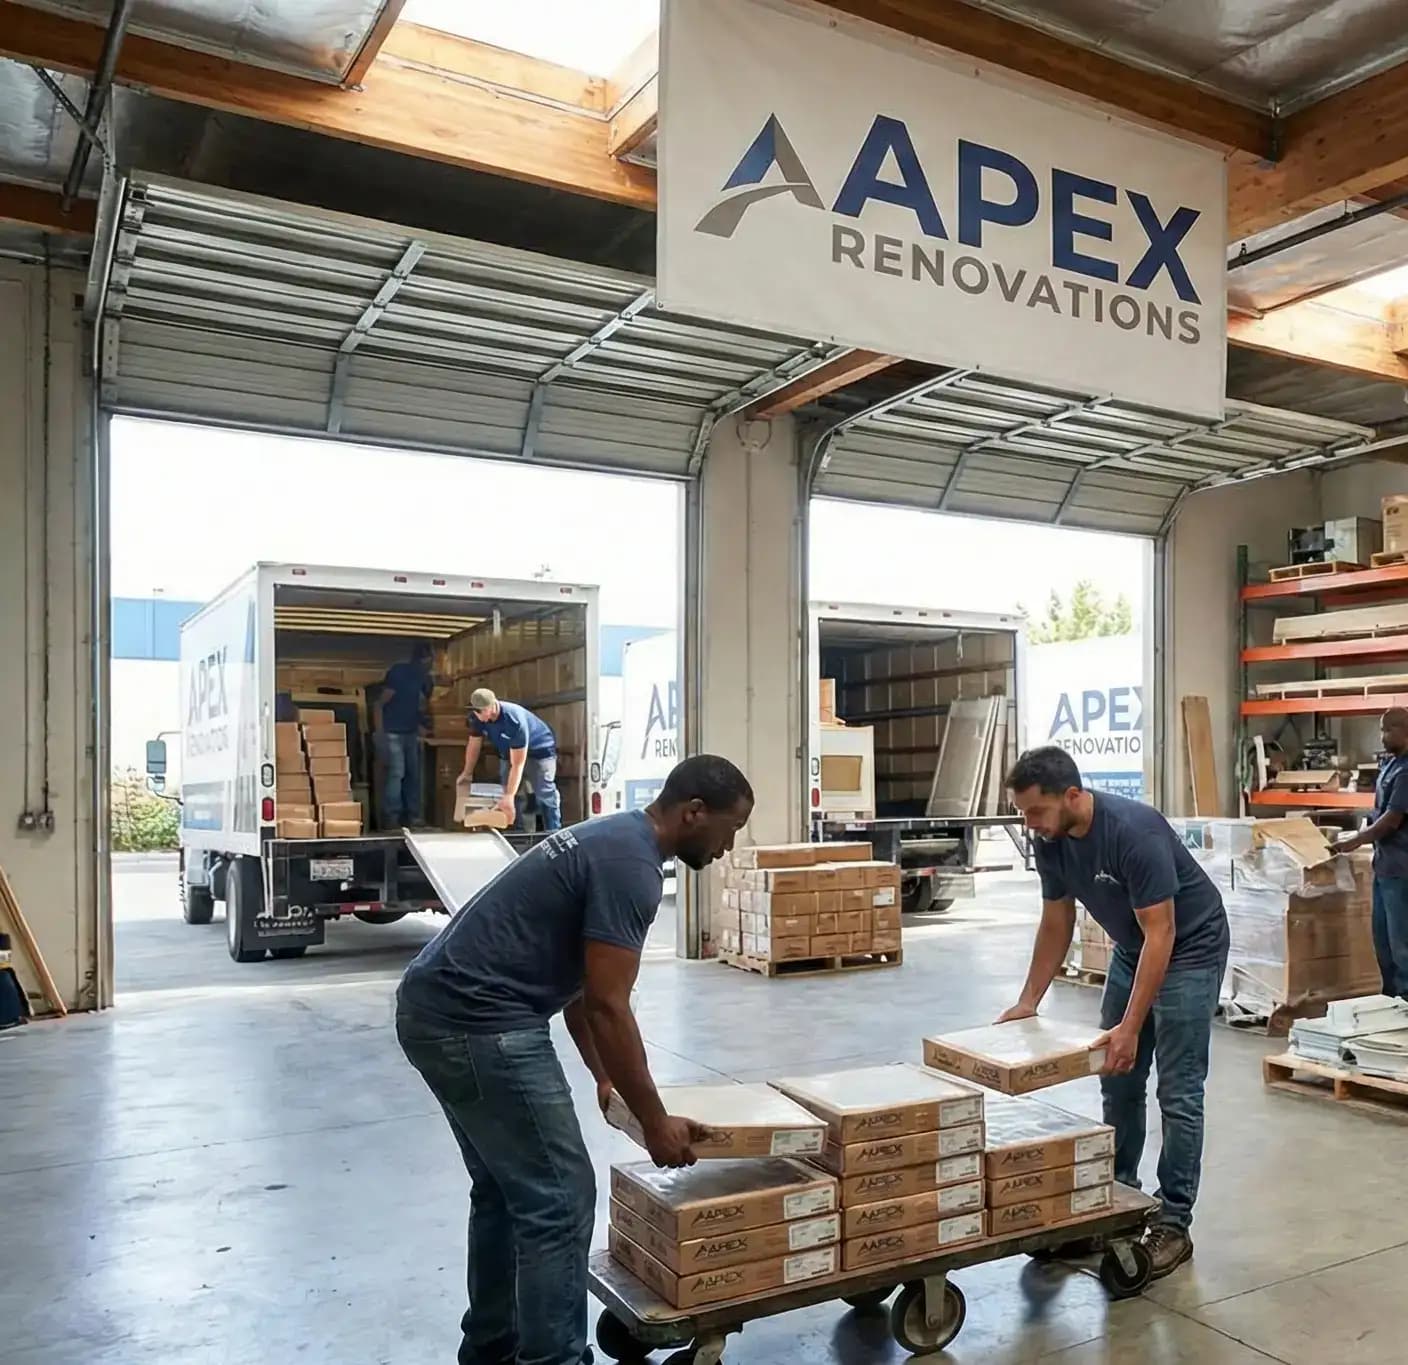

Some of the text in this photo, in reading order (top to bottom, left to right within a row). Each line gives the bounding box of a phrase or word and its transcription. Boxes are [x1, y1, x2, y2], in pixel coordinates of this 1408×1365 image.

[832, 114, 1201, 305] APEX
[832, 223, 1201, 346] RENOVATIONS
[188, 645, 228, 726] APEX
